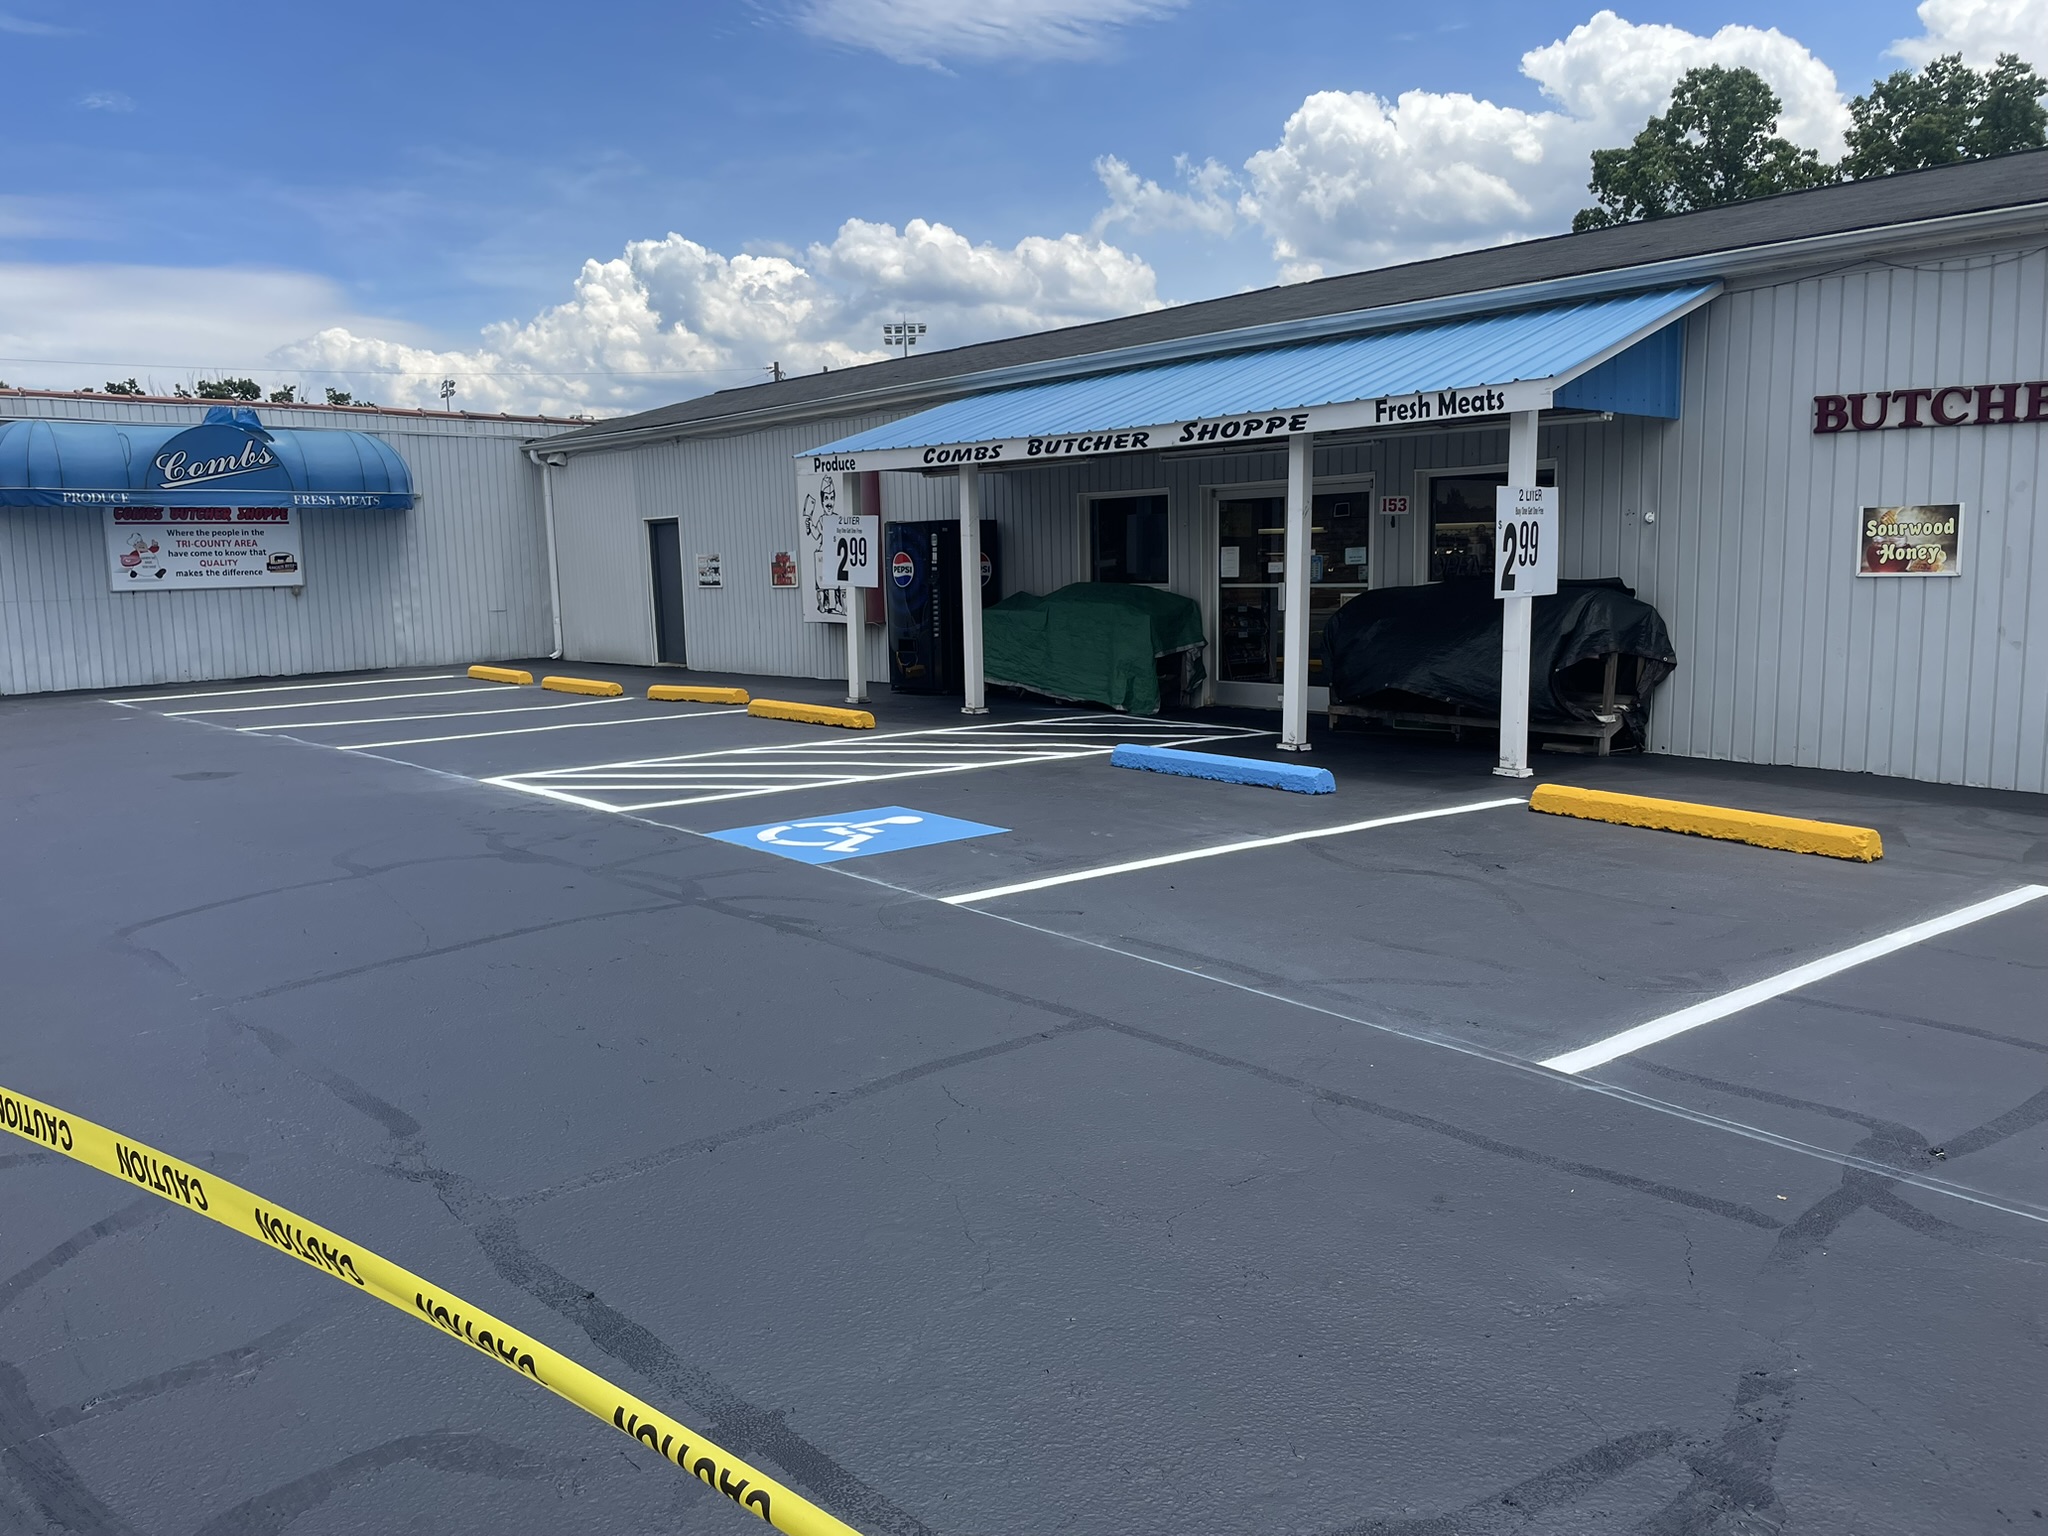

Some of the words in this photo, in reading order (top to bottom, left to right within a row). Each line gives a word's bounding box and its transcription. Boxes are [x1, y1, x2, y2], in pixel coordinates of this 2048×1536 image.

[1376, 395, 1430, 422] Fresh
[1438, 389, 1504, 416] Meats
[923, 445, 1003, 464] COMBS
[1027, 431, 1150, 456] BUTCHER
[1179, 414, 1309, 442] SHOPPE
[155, 440, 275, 482] Combs
[813, 456, 856, 472] Produce
[62, 492, 130, 504] PRODUCE
[339, 495, 381, 506] MEATS
[1519, 489, 1524, 501] 2
[1525, 489, 1543, 501] LITER
[1382, 498, 1407, 512] 153
[838, 516, 842, 524] 2
[212, 529, 239, 538] people
[1866, 518, 1954, 537] Sourwood
[176, 540, 232, 548] TRI-COUNTY
[1879, 543, 1940, 564] Honey
[199, 559, 238, 567] QUALITY
[893, 565, 912, 574] PEPSI
[115, 1142, 208, 1211] CAUTION
[254, 1207, 365, 1286] CAUTION
